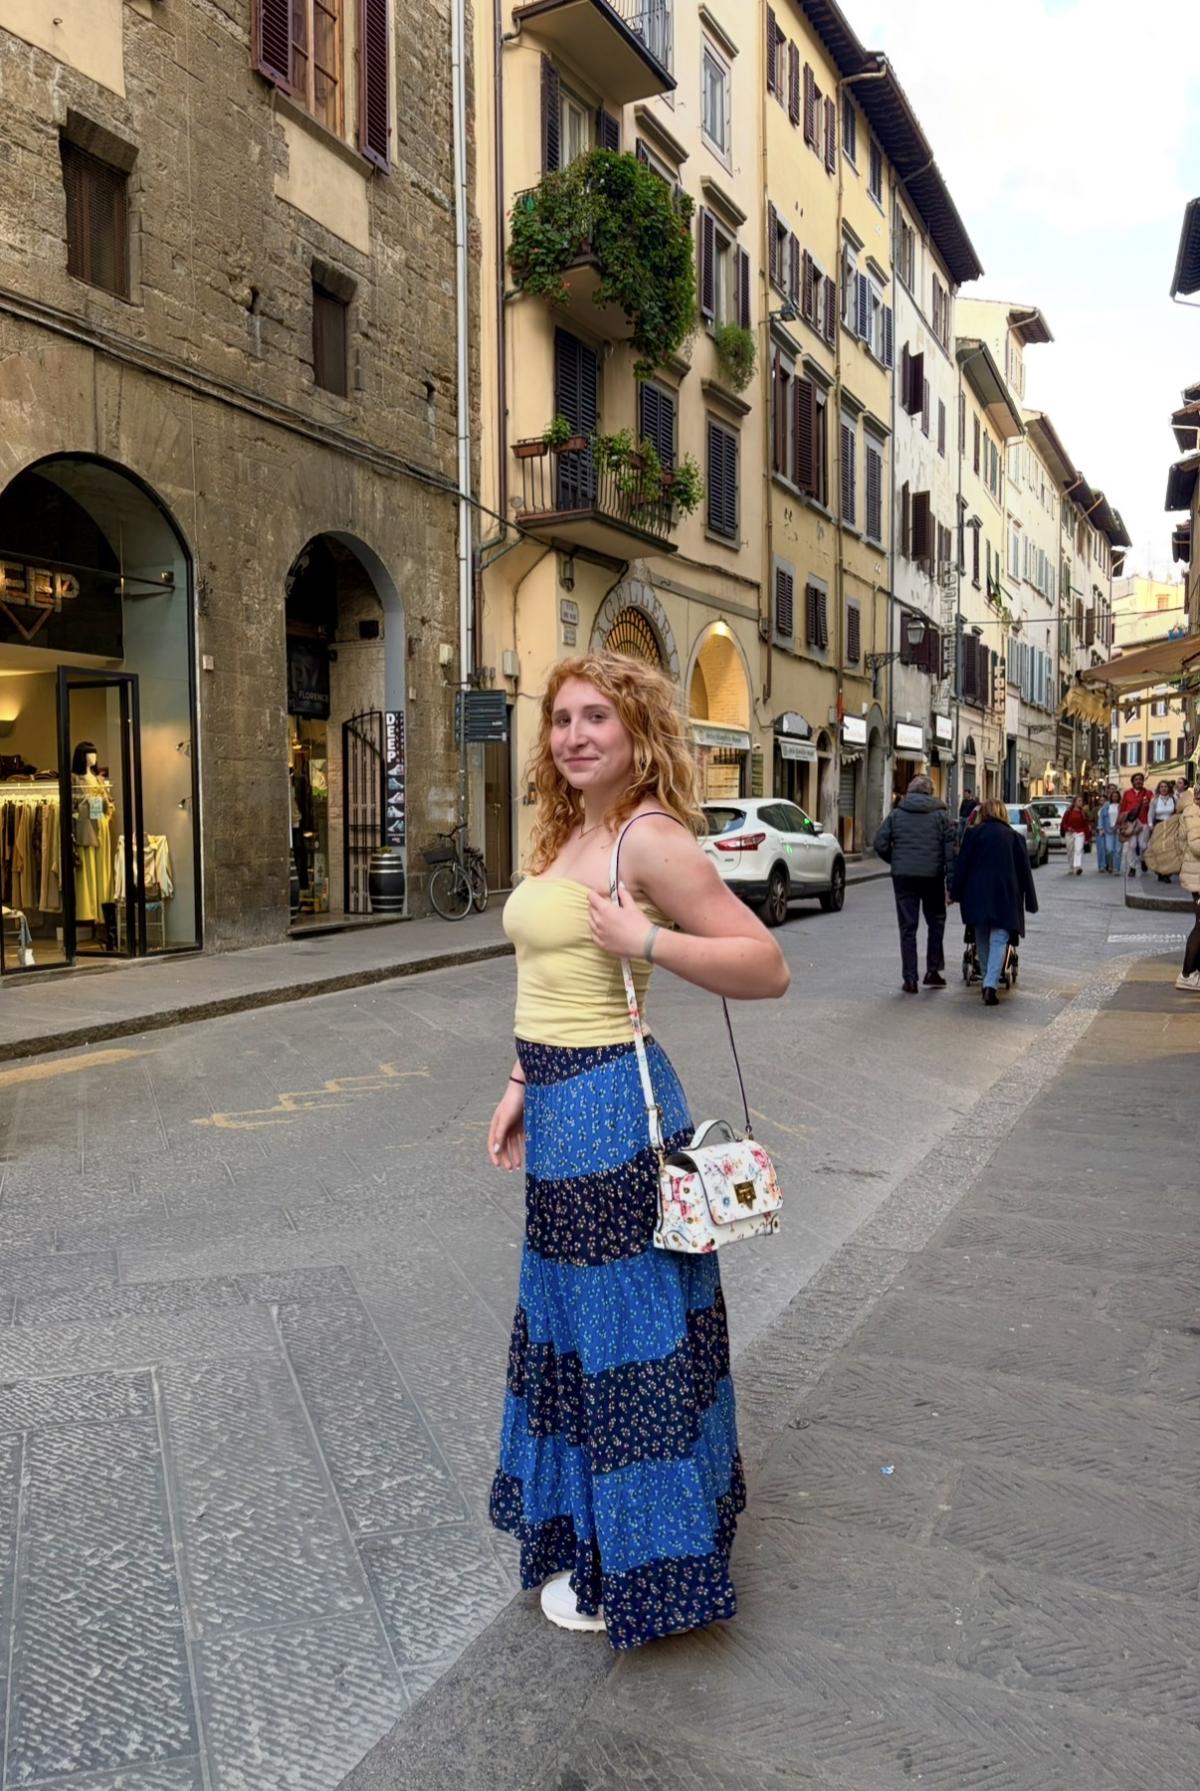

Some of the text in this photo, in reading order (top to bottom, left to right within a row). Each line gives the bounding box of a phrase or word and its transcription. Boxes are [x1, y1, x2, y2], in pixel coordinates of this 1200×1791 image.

[589, 578, 681, 683] ACELLERIA
[994, 665, 1005, 724] FORNO
[386, 712, 397, 763] DEEP
